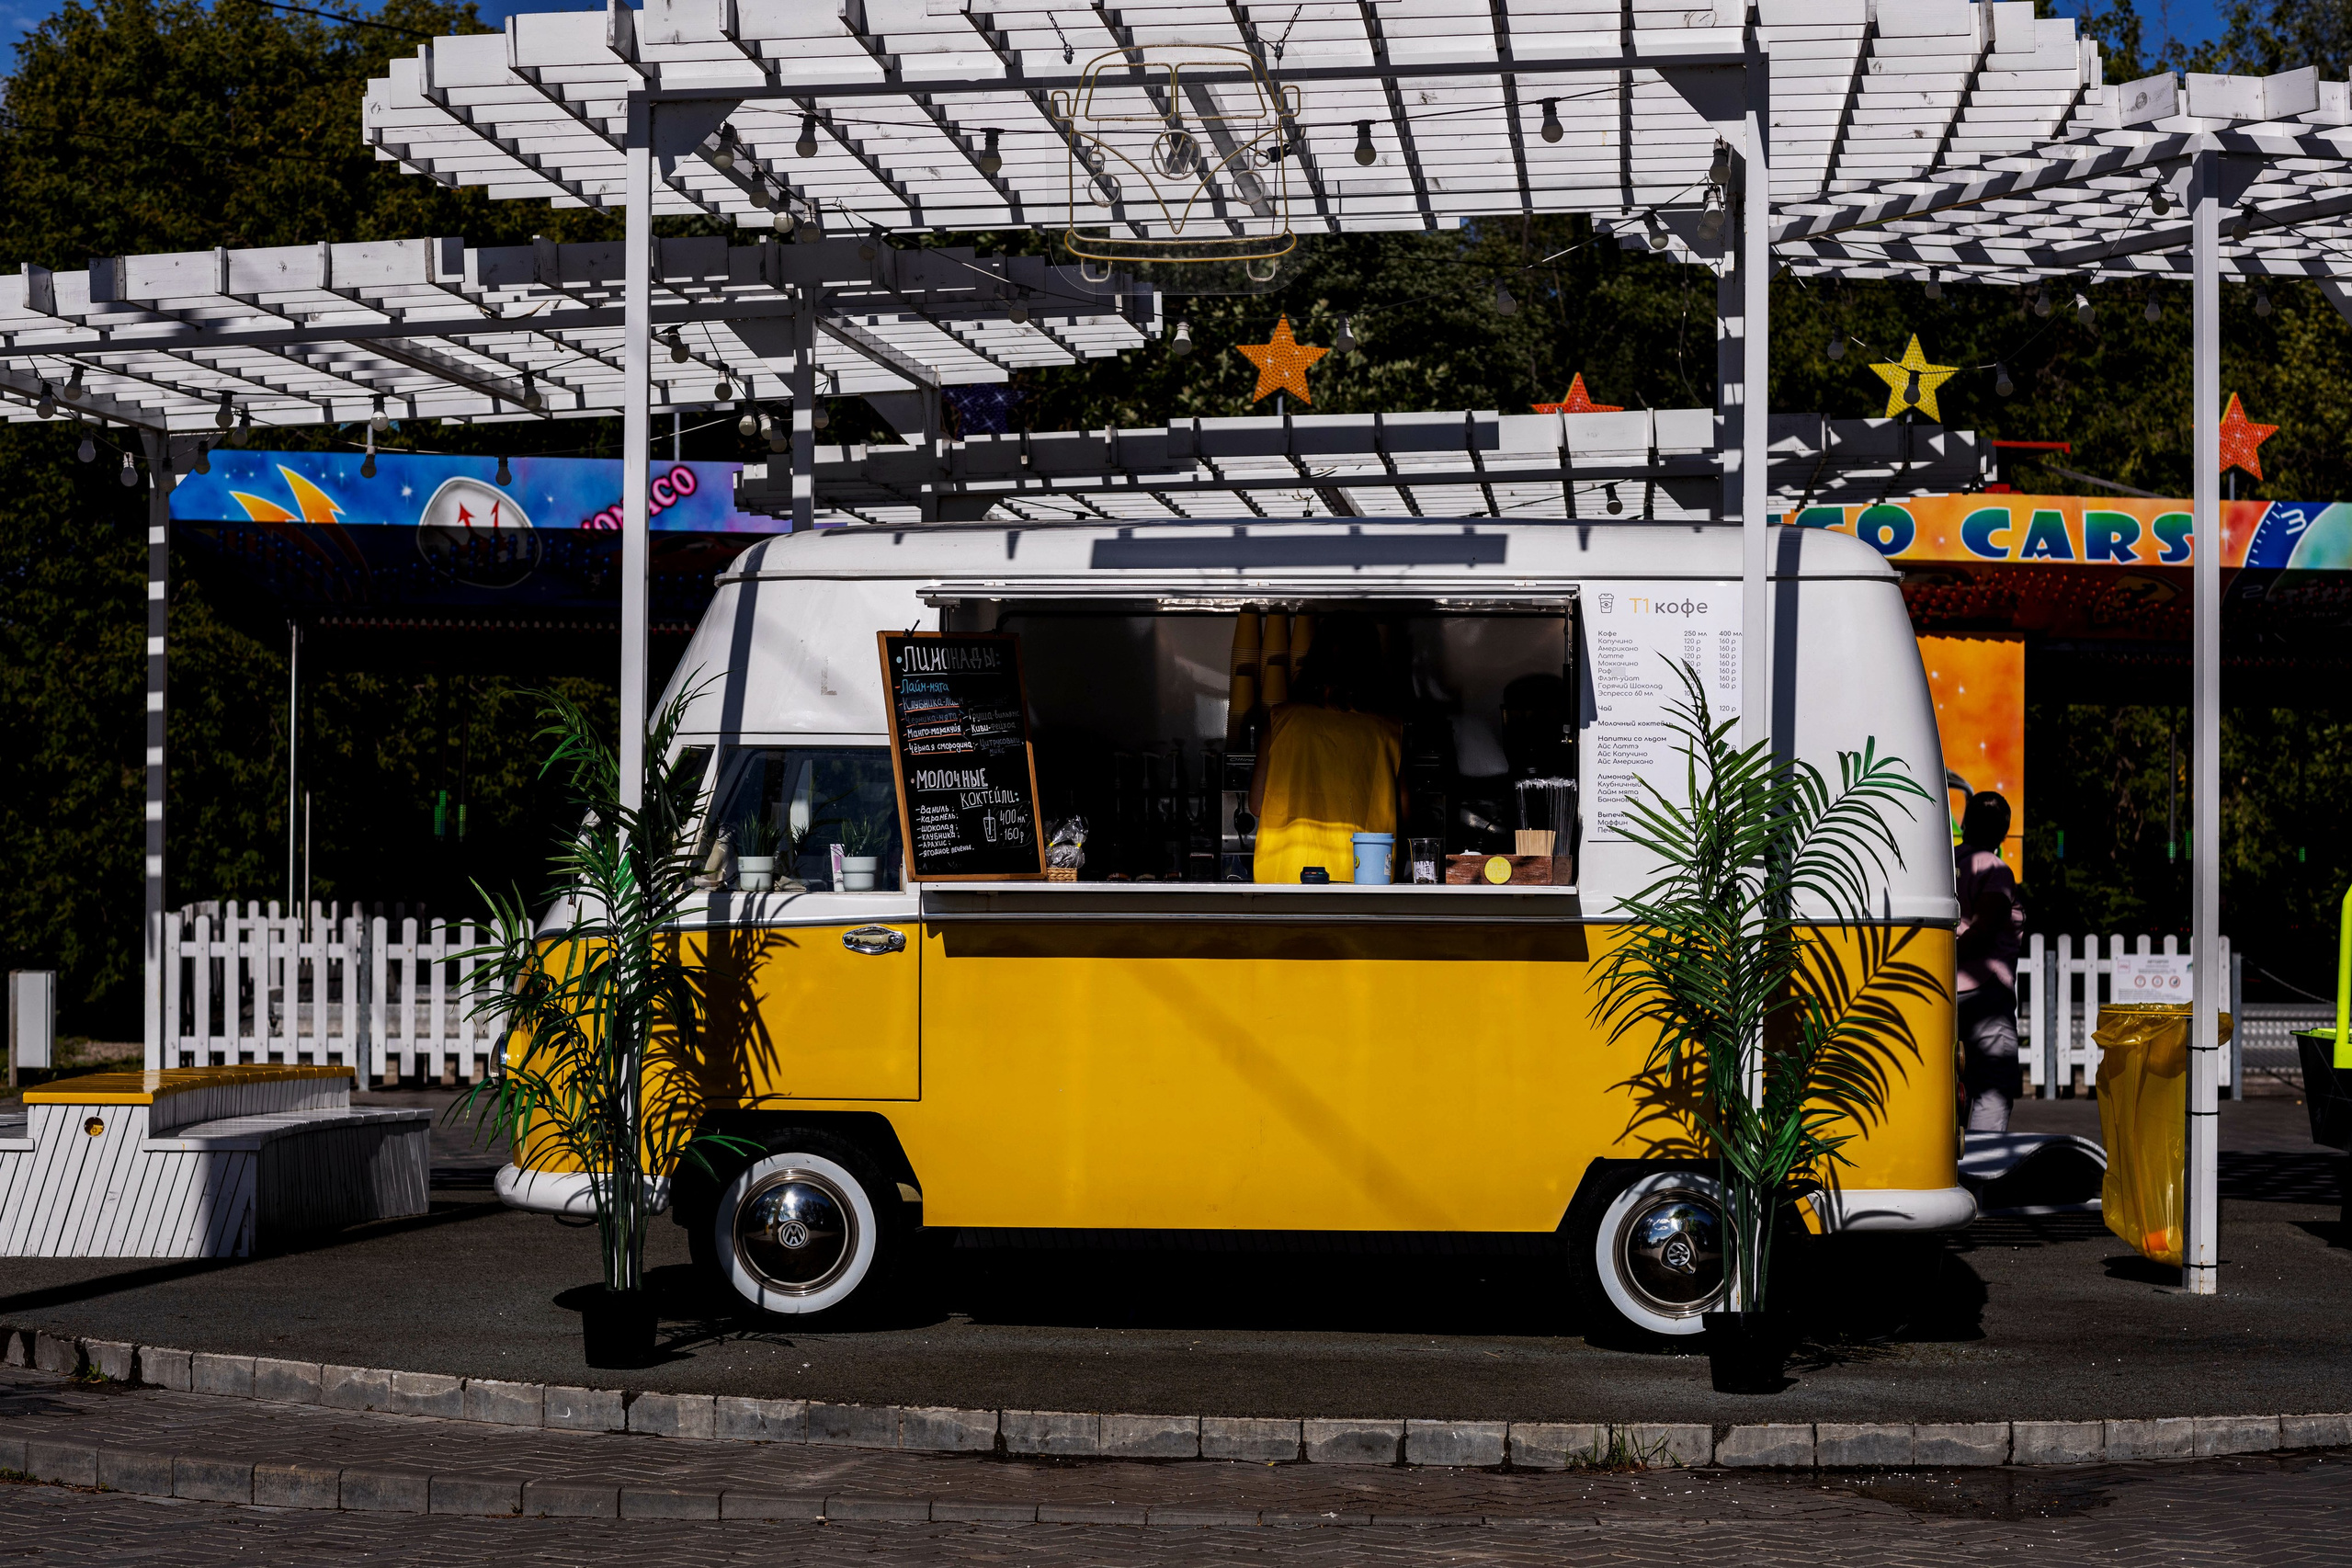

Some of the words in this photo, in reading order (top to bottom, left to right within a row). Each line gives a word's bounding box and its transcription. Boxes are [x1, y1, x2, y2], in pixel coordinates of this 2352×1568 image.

[1960, 506, 2194, 564] CARS
[1629, 597, 1649, 614] T1
[1655, 597, 1708, 618] кофе
[1000, 809, 1017, 825] 400
